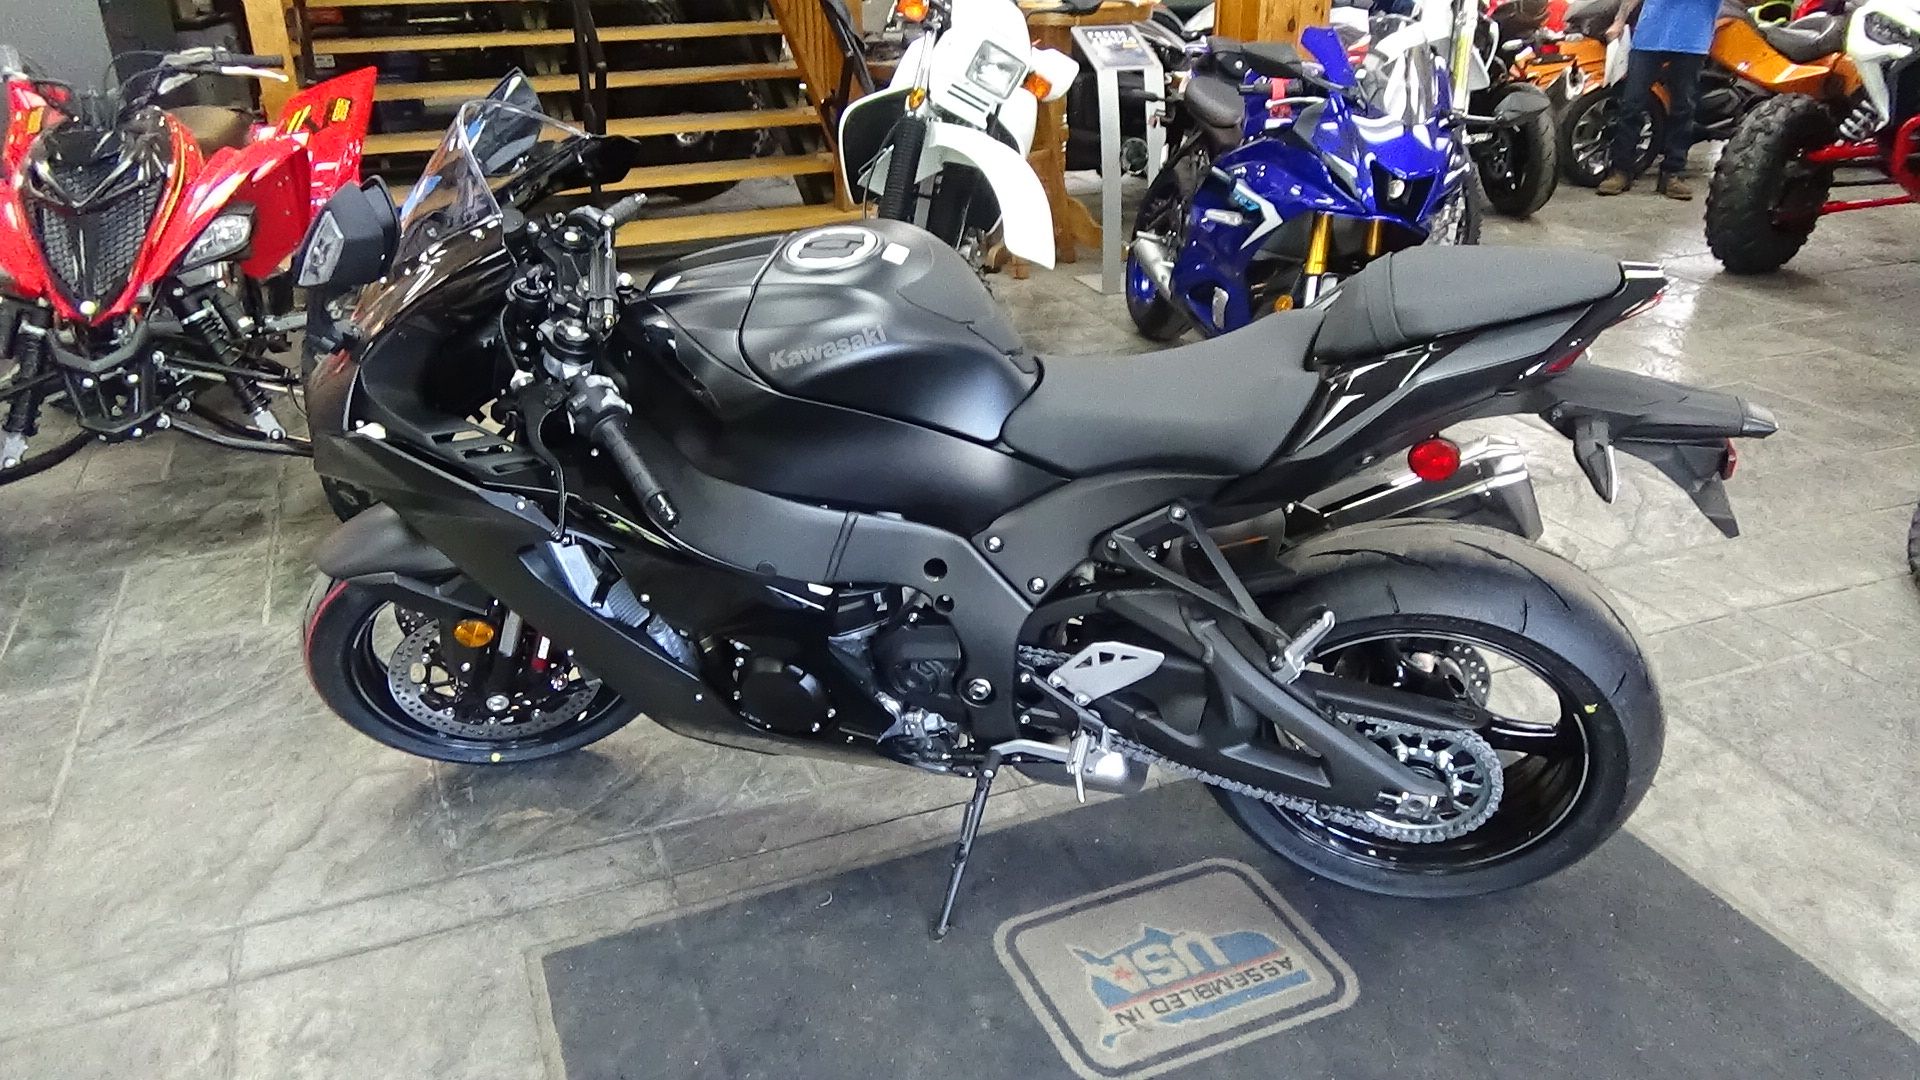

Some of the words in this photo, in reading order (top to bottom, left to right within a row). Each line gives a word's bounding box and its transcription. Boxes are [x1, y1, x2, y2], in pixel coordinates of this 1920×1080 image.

[768, 324, 887, 371] Kawasaki
[1086, 932, 1231, 994] USA
[1149, 956, 1294, 1015] ASSEMBLED
[1114, 1006, 1145, 1026] IN
